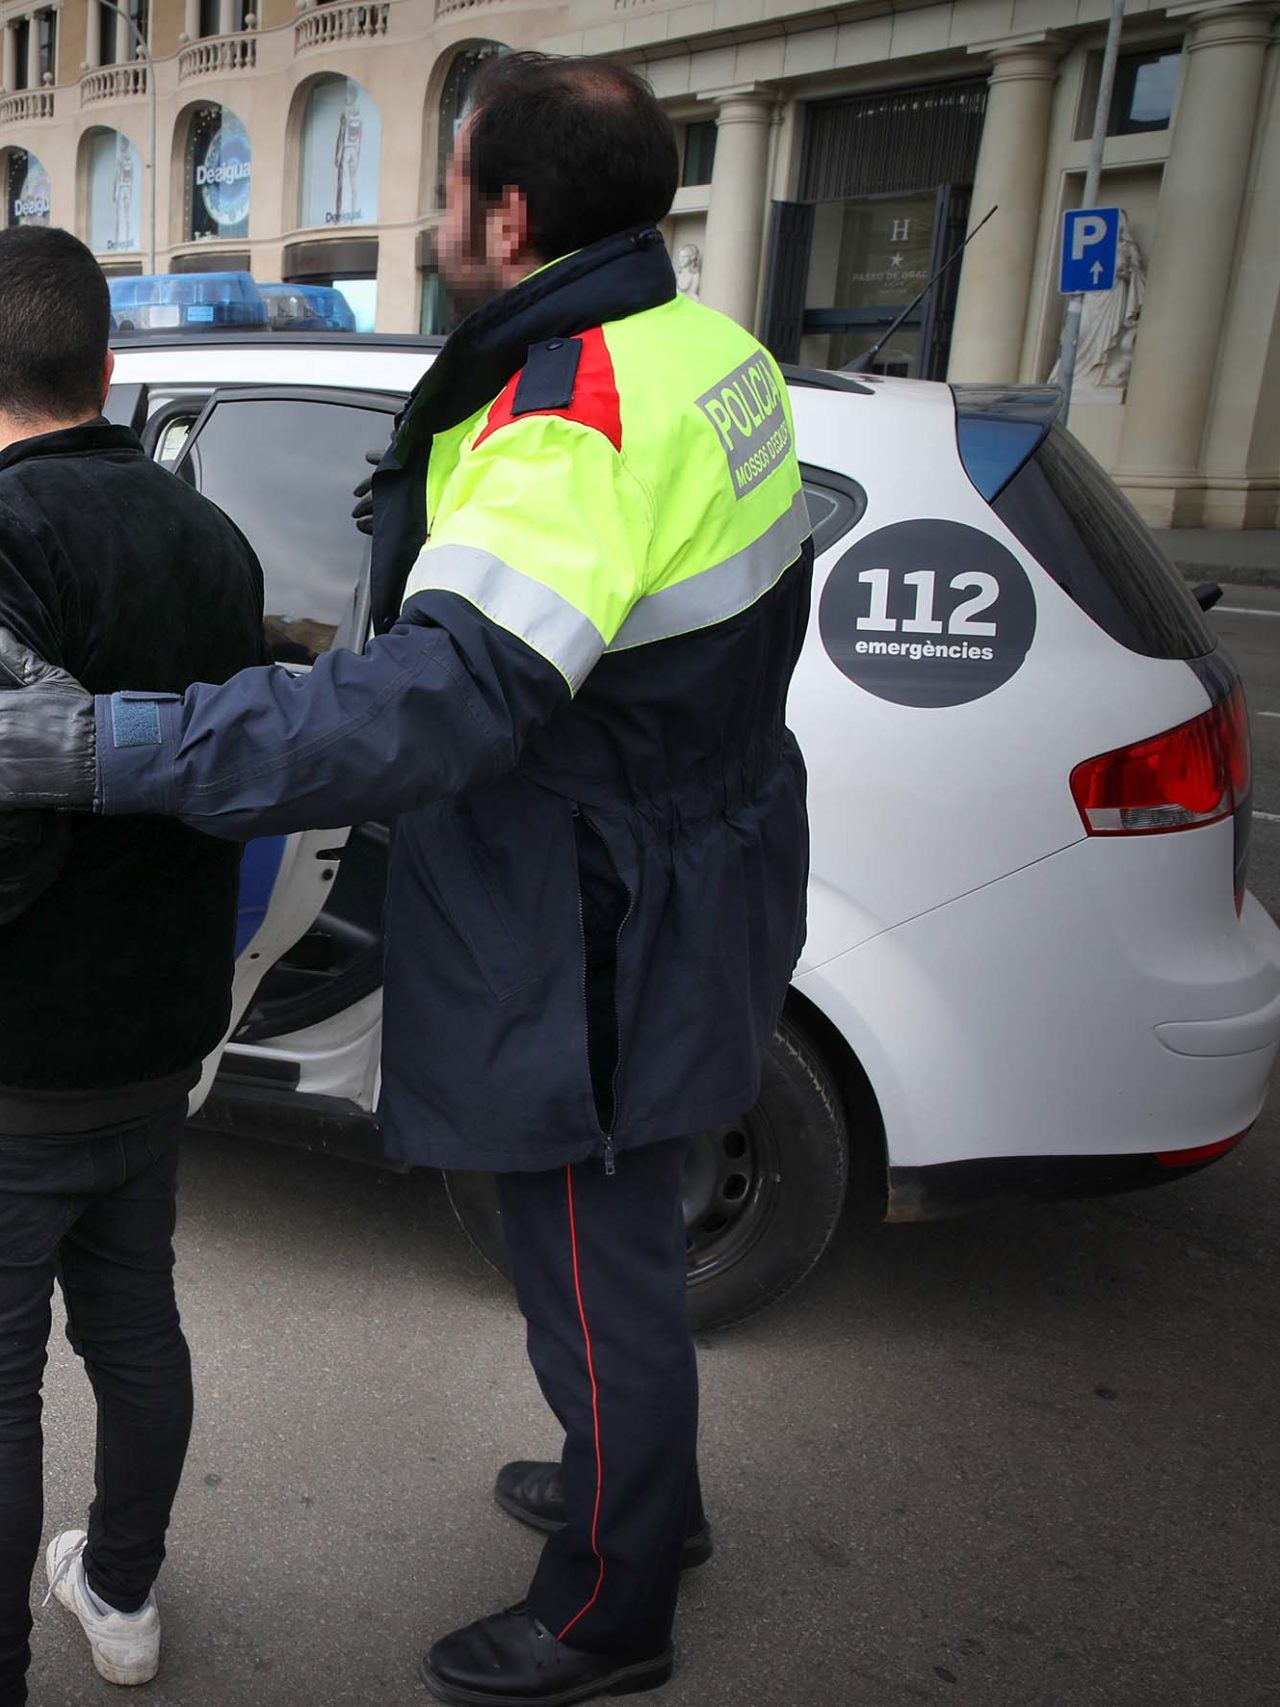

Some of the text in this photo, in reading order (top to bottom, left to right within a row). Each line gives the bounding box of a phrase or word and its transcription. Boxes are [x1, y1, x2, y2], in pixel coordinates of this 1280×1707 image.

[890, 219, 910, 241] H
[1071, 215, 1107, 260] P
[704, 360, 782, 451] POLICIA
[735, 446, 770, 489] MOSSOS
[856, 568, 1000, 637] 112
[855, 640, 994, 660] emergències
